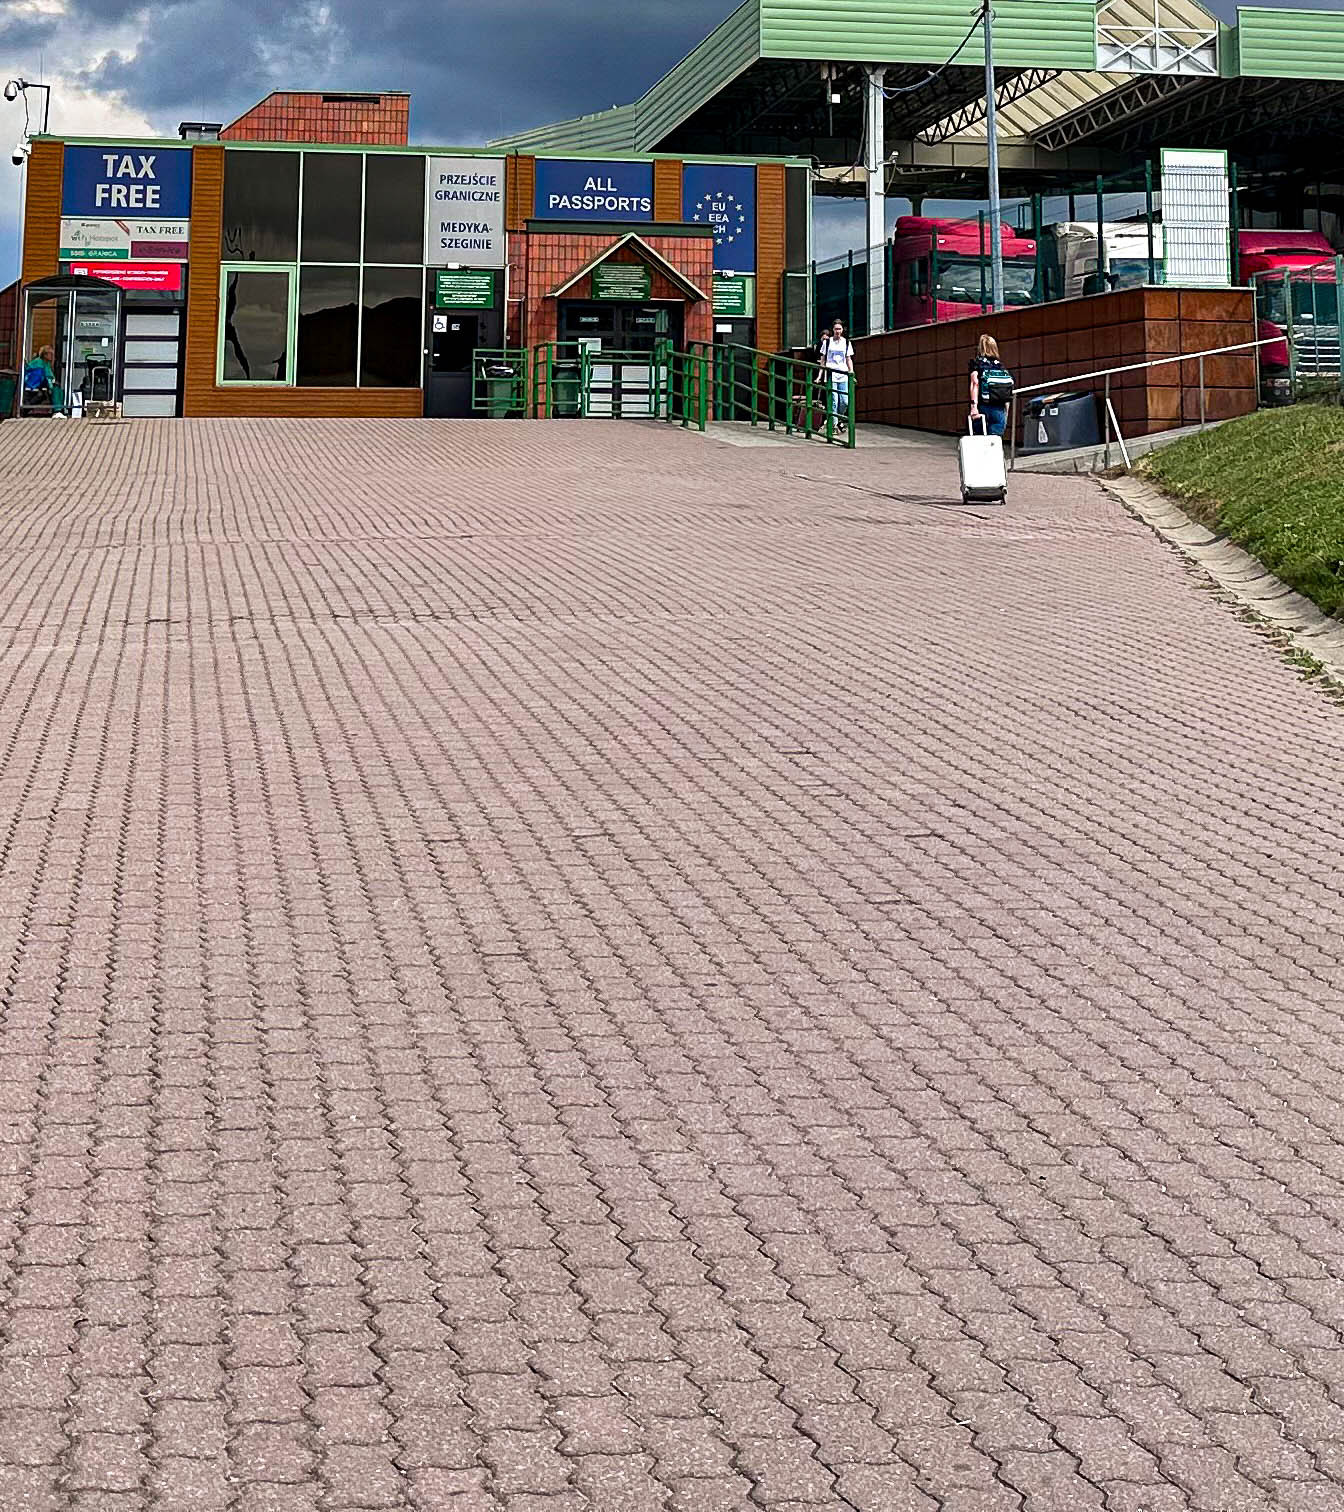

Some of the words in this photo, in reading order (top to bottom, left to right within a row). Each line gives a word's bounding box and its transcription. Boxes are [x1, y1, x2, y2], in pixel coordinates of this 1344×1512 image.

[102, 154, 156, 179] TAX
[439, 172, 497, 186] PRZEJŚCIE
[583, 176, 617, 192] ALL
[95, 183, 161, 208] FREE
[434, 190, 500, 202] GRANICZNE
[549, 194, 651, 212] PASSPORTS
[712, 202, 726, 211] EU
[708, 213, 730, 223] EEA
[137, 226, 156, 234] TAX
[158, 226, 185, 235] FREE
[440, 222, 493, 233] MEDYKA-
[440, 237, 492, 249] SZEGINIE
